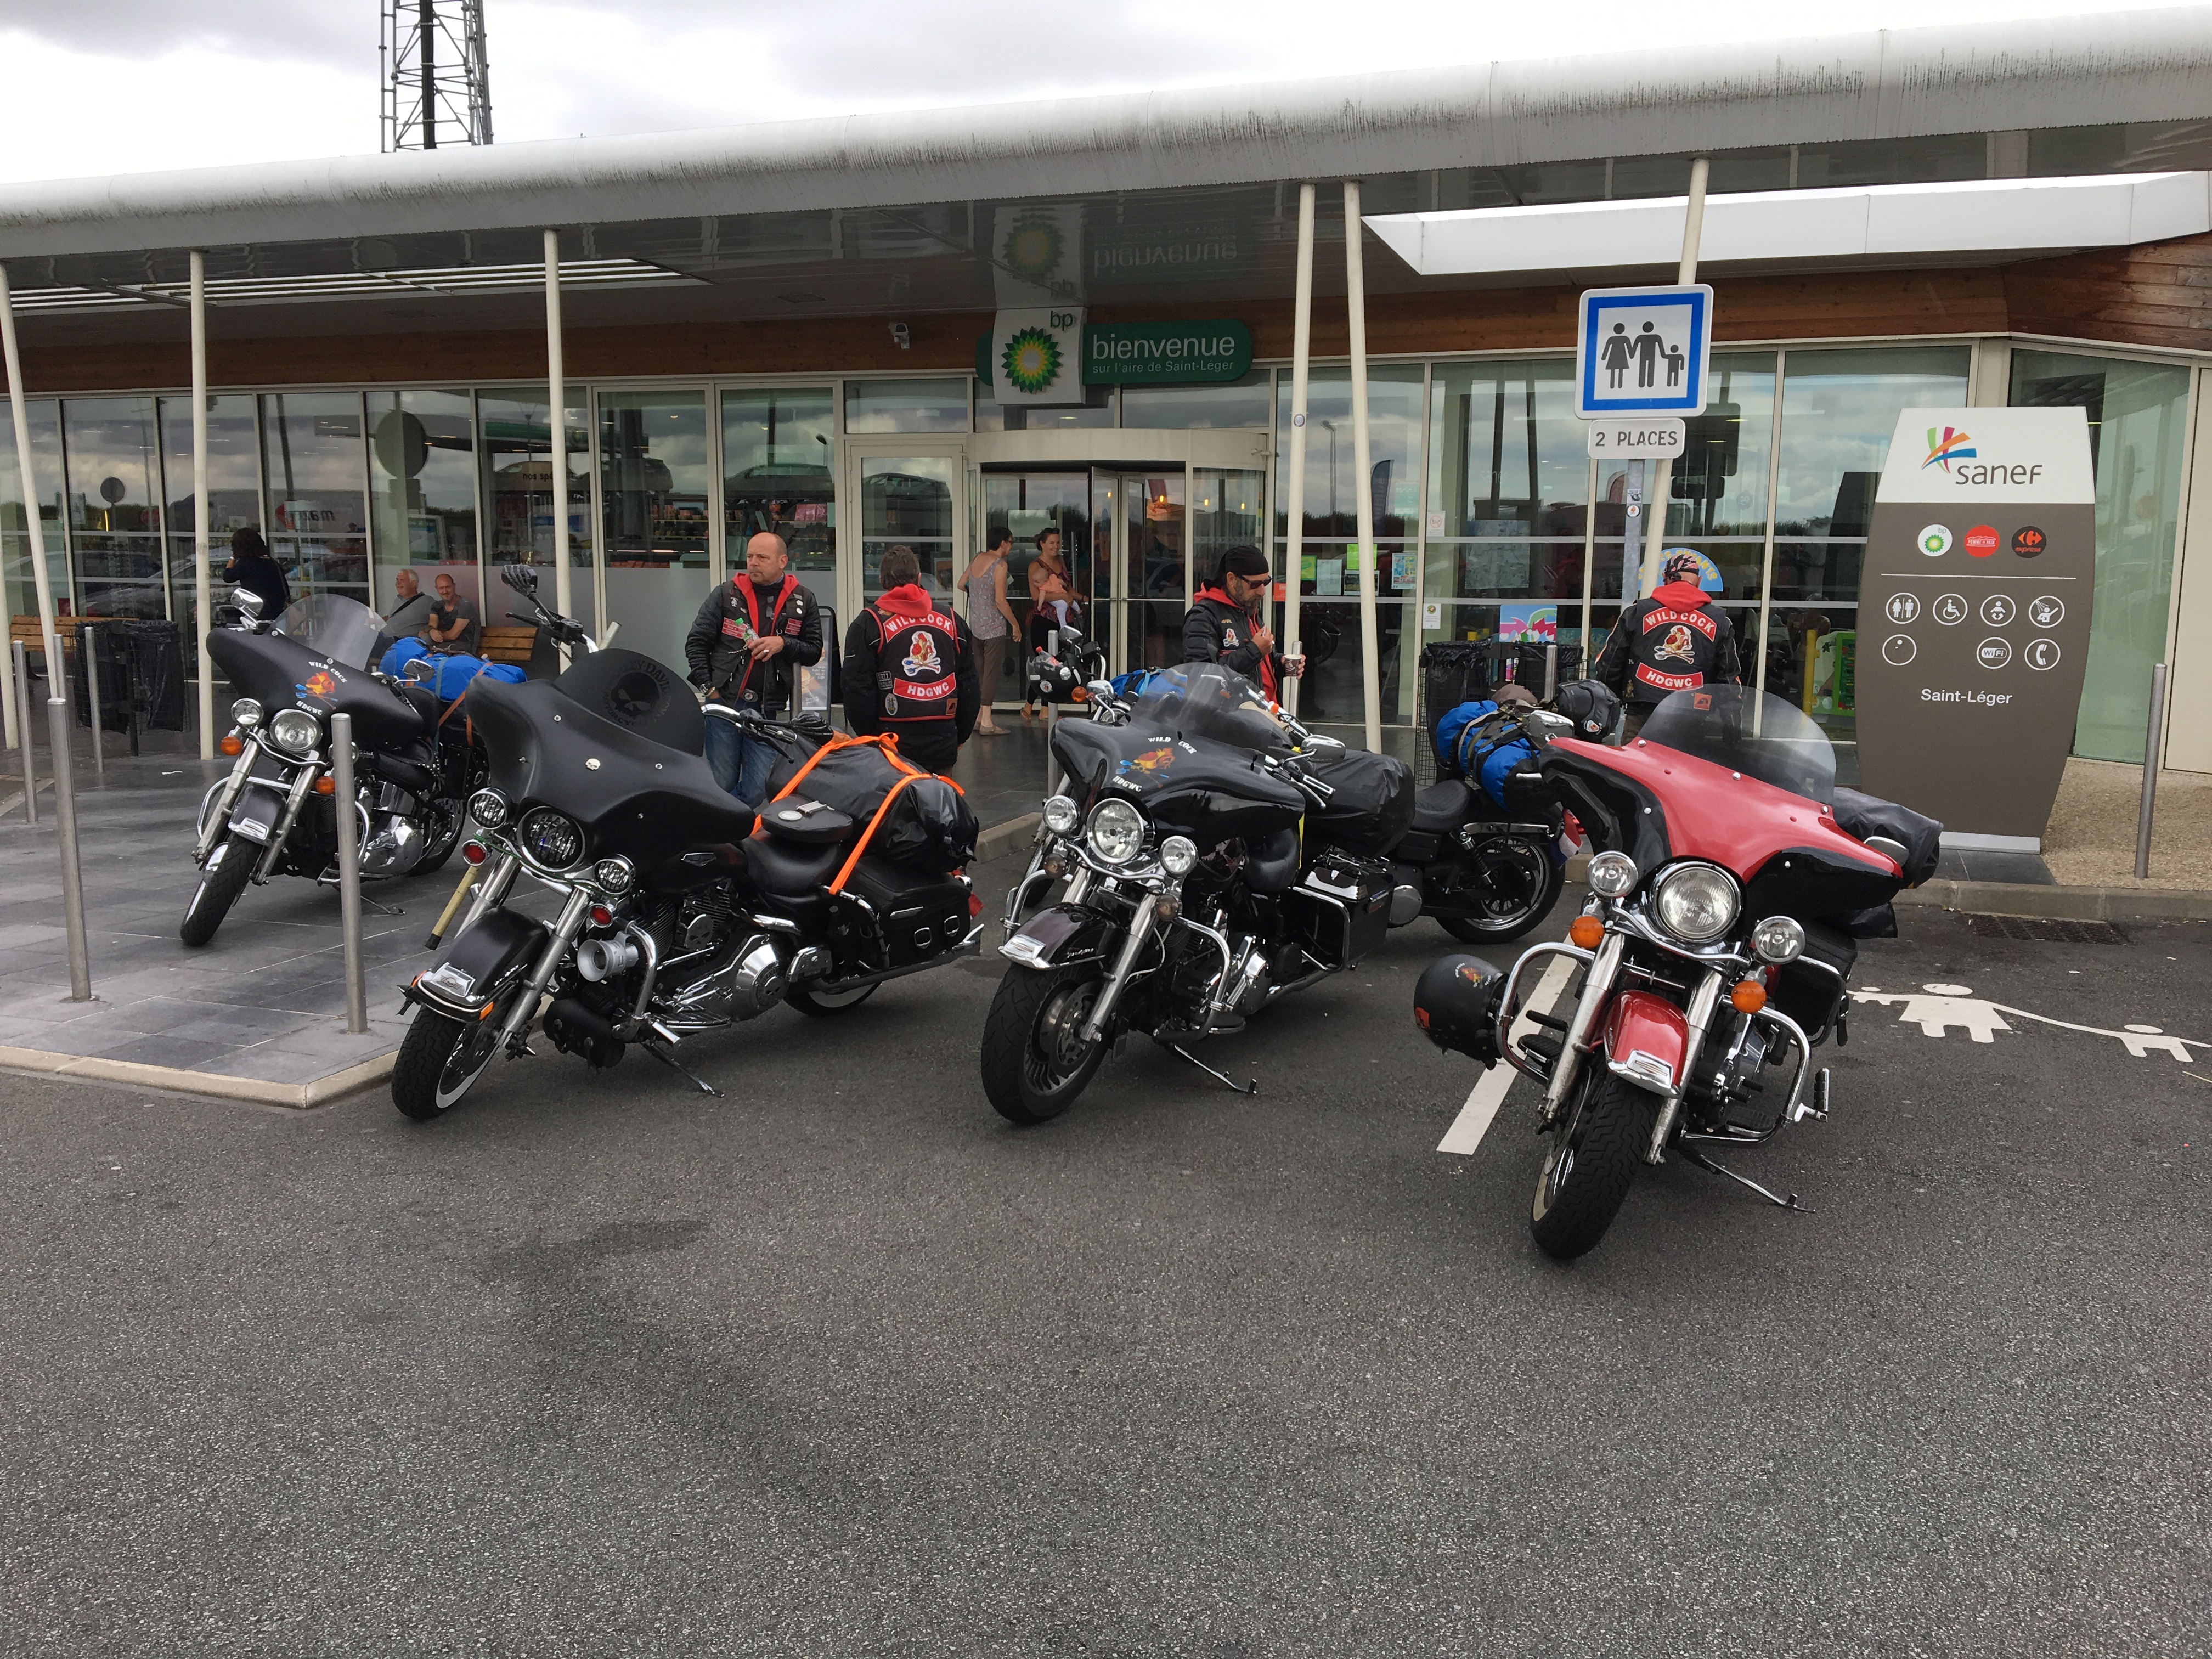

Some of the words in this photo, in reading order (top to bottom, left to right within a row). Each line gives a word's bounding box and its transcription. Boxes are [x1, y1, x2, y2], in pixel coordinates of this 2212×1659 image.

[1049, 310, 1074, 331] bp
[1092, 333, 1235, 360] bienvenue
[1093, 364, 1110, 374] sur
[1115, 362, 1143, 373] l'aire
[1147, 362, 1161, 372] de
[1165, 359, 1234, 373] Saint-Léger
[1595, 431, 1606, 447] 2
[1617, 431, 1678, 447] PLACES
[1955, 464, 2043, 485] sanef
[1938, 527, 1947, 535] bp
[885, 616, 916, 632] WILD
[1645, 610, 1677, 625] WILD
[1680, 612, 1715, 633] COCK
[308, 661, 329, 669] WILD
[330, 668, 347, 683] COCK
[1646, 670, 1692, 688] HDGWC
[907, 682, 949, 697] HDGWC
[1921, 689, 2013, 706] Saint-Léger
[295, 700, 323, 715] HDGWC
[1178, 741, 1197, 754] COCK
[1112, 775, 1143, 792] HDGWC
